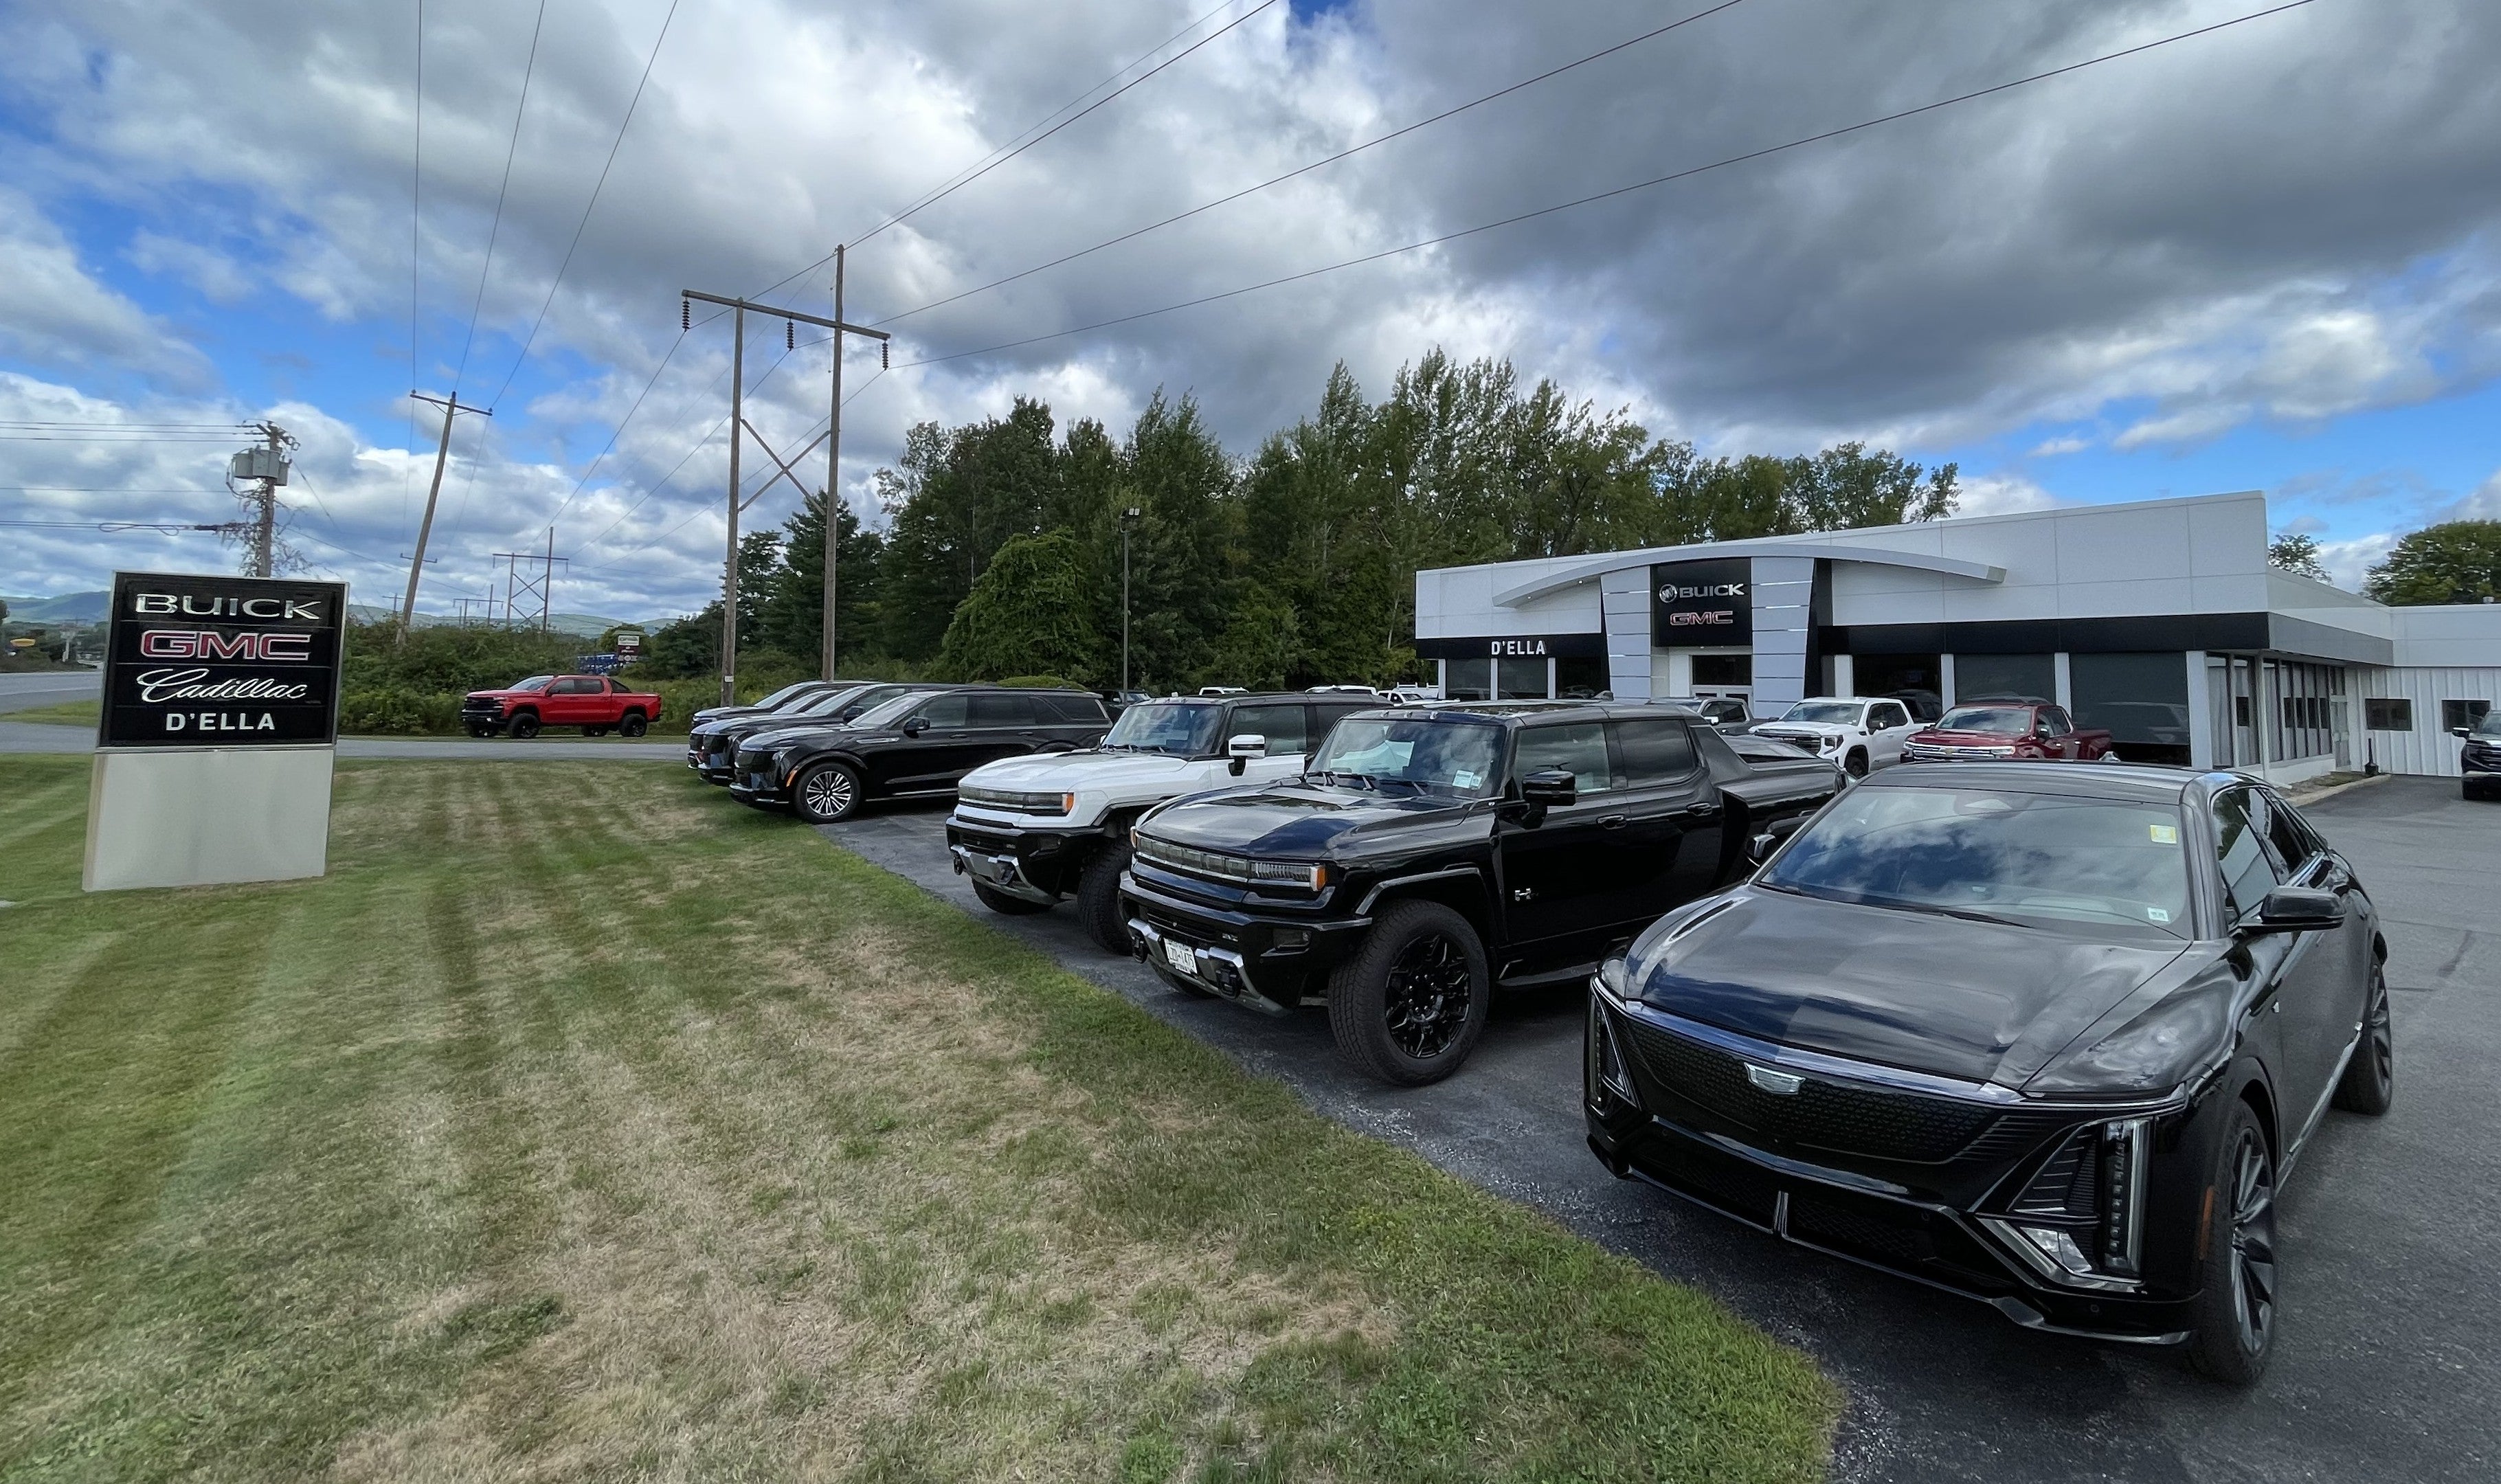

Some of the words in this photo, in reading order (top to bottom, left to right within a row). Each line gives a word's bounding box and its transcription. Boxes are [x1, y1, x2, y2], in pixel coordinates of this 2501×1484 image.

[1679, 583, 1745, 598] BUICK
[136, 594, 322, 620] BUICK
[1670, 610, 1734, 626] GMC
[141, 630, 311, 660] GMC
[1491, 640, 1546, 655] D'ELLA
[136, 668, 307, 702] Cadillac
[166, 713, 276, 731] D'ELLA
